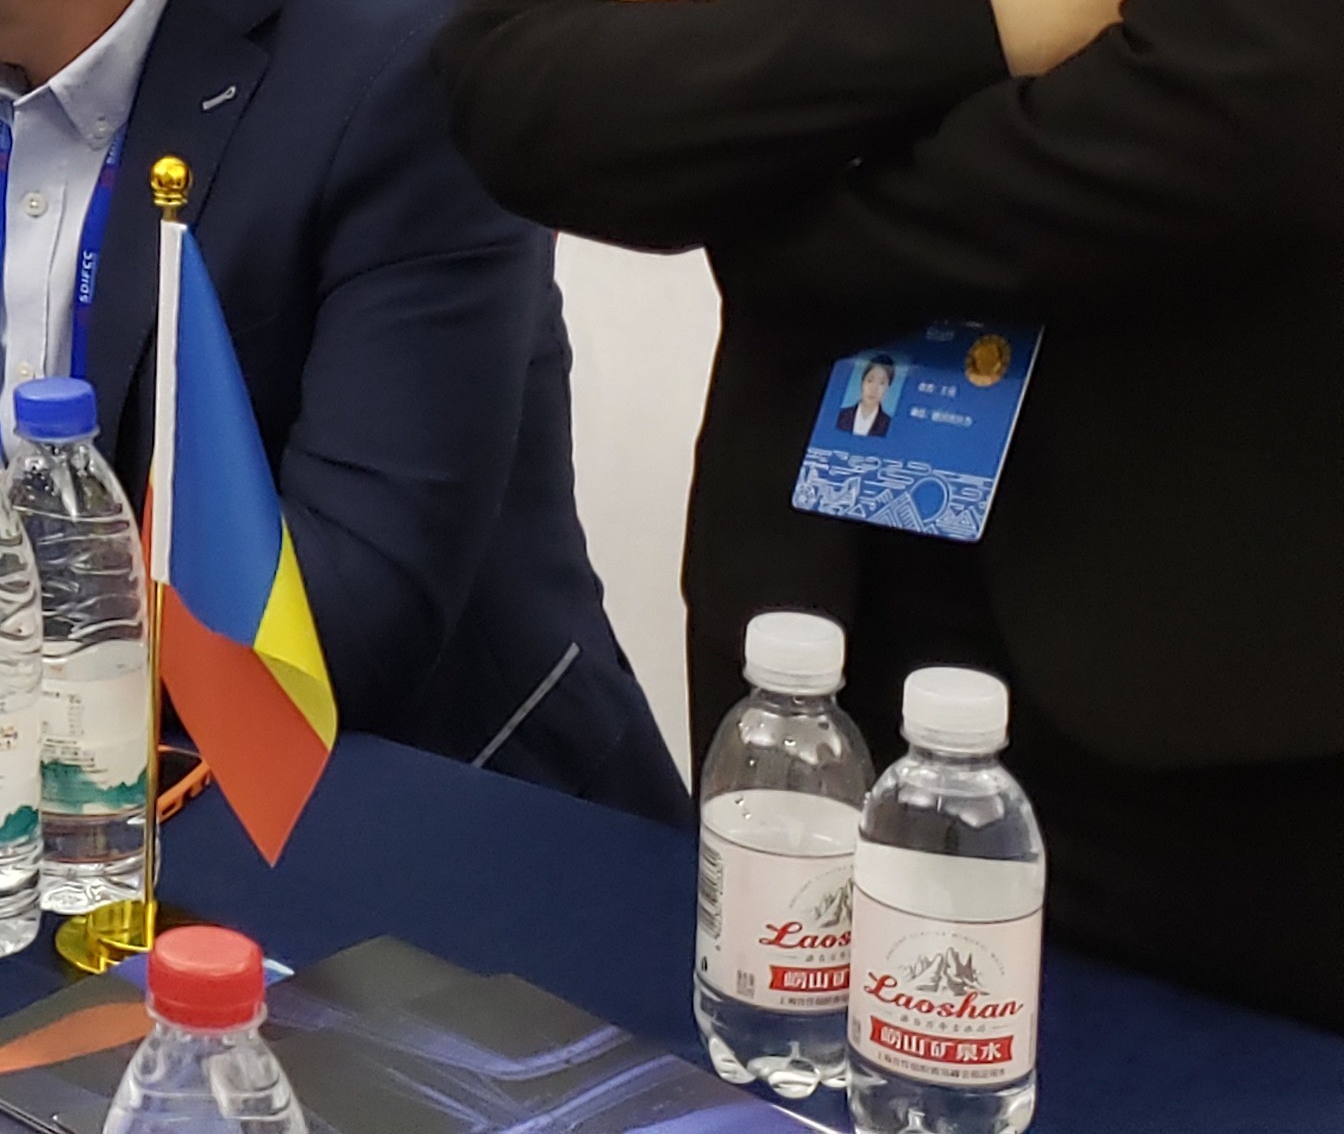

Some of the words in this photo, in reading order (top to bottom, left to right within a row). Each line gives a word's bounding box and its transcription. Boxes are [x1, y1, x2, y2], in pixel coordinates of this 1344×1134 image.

[79, 250, 95, 304] SDIFCC
[758, 921, 852, 949] Laos
[864, 971, 1024, 1019] Laoshan
[880, 1026, 1002, 1061] 崂山矿泉水
